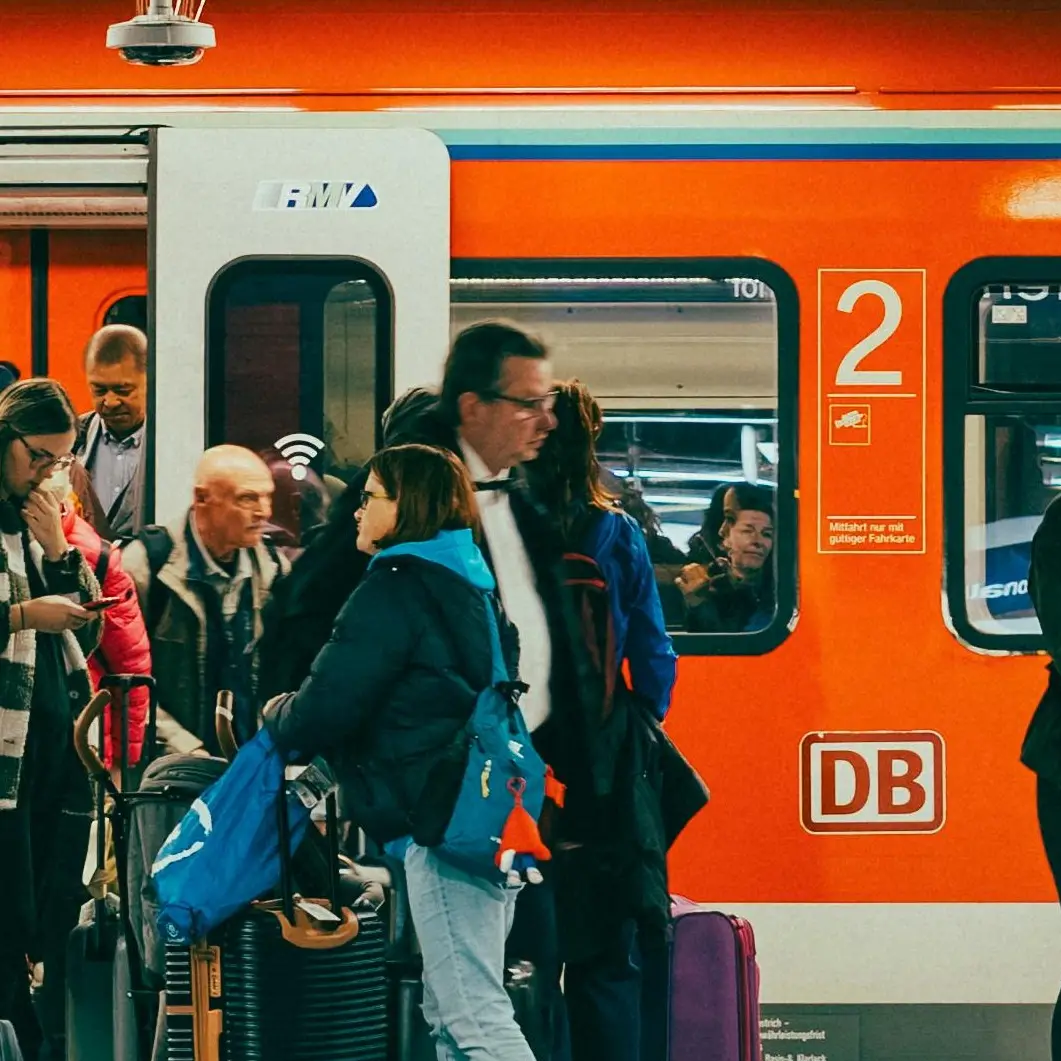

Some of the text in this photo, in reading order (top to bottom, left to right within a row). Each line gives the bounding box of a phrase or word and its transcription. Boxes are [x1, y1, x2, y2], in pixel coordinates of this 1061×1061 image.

[279, 181, 366, 209] RMV
[835, 279, 902, 386] 2
[868, 533, 916, 544] Fahrkarte
[869, 523, 886, 532] nur
[888, 522, 904, 532] mit
[820, 750, 926, 815] DB
